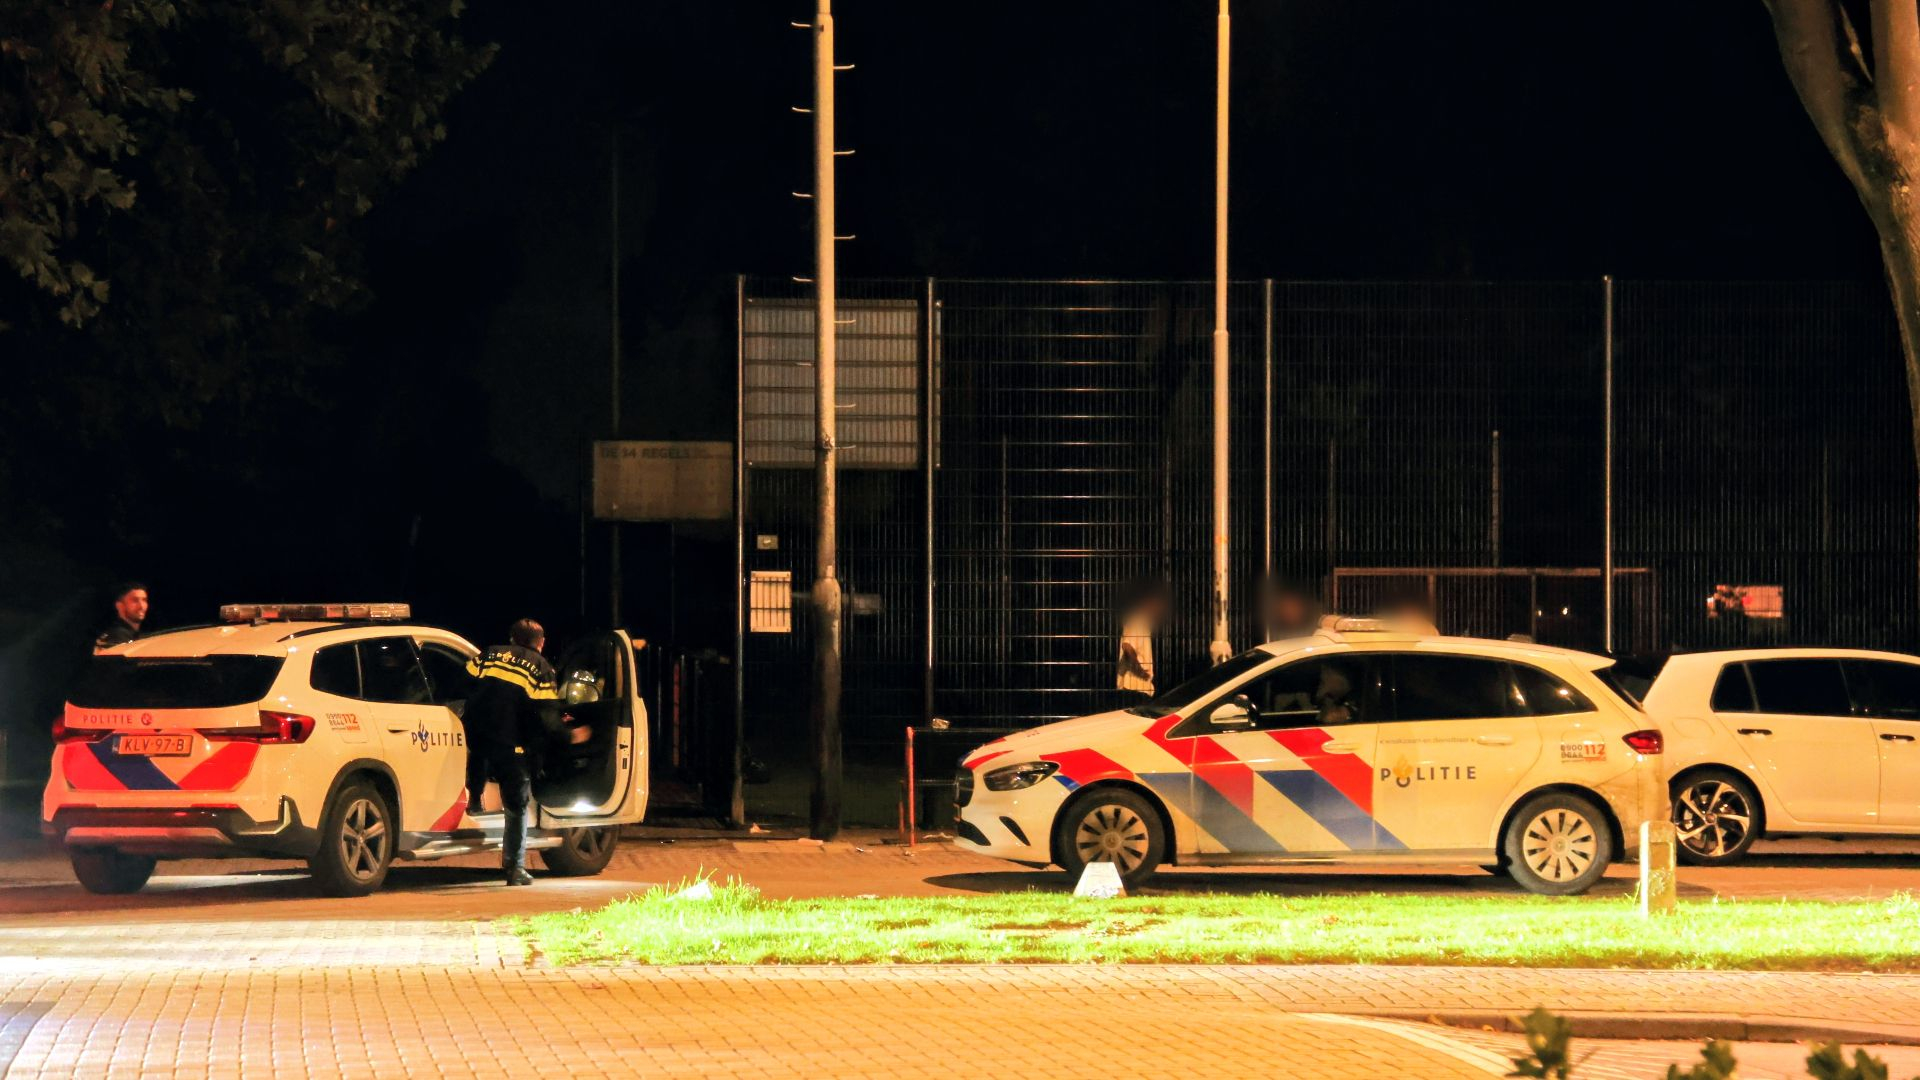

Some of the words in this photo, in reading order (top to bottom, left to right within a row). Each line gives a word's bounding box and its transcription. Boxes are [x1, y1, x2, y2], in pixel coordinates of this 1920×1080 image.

[496, 651, 537, 672] POLITIE
[82, 714, 133, 725] POLITIE
[342, 713, 358, 724] 112
[411, 731, 463, 753] POLITIE
[1583, 743, 1605, 755] 112
[1380, 765, 1477, 788] POLITIE
